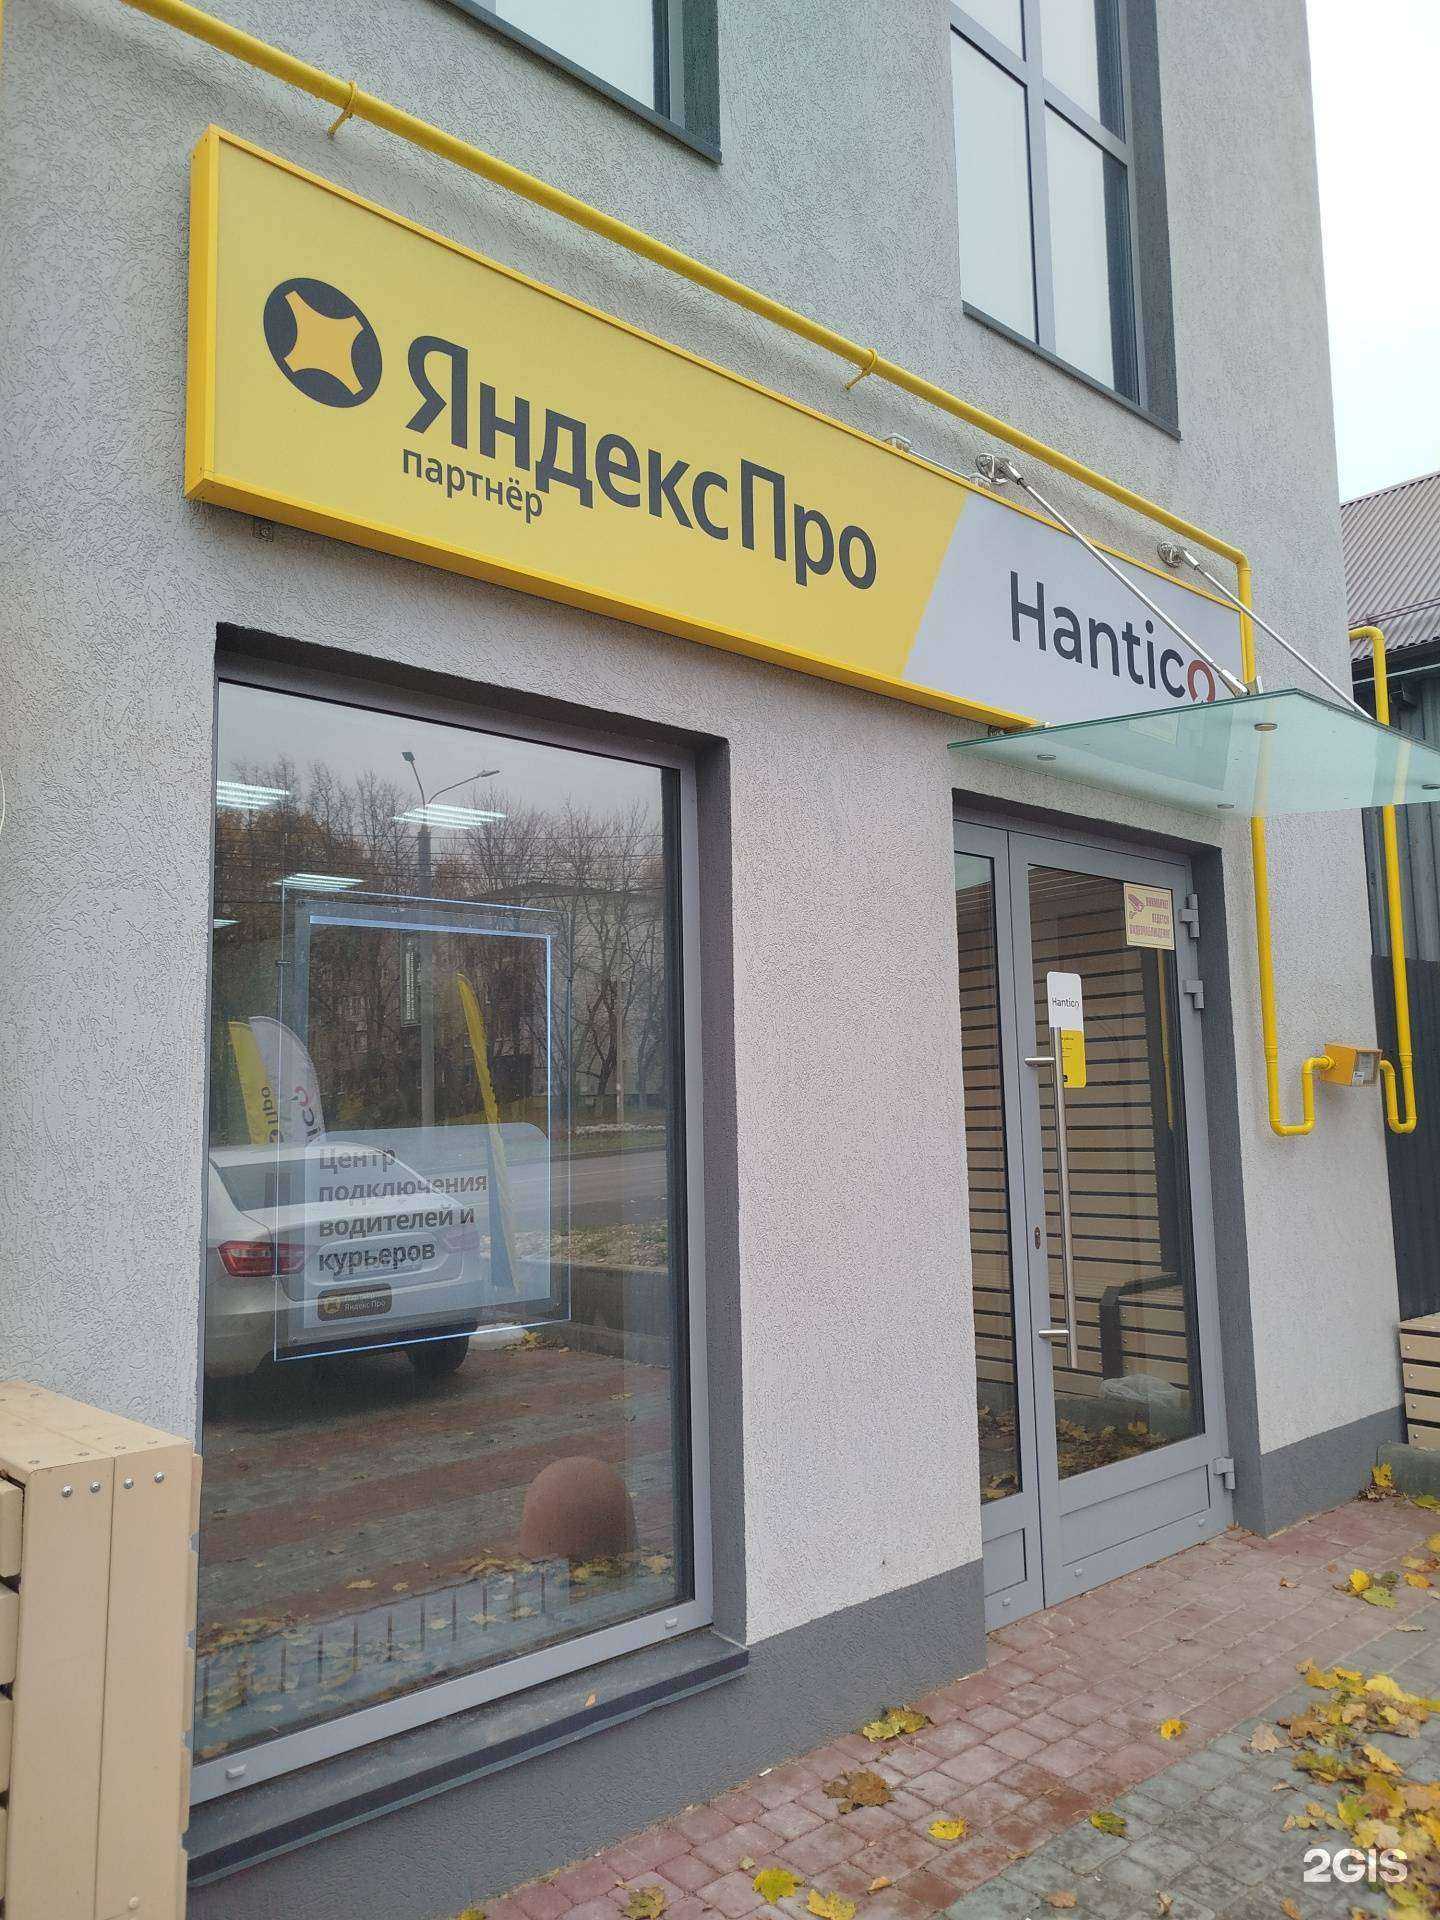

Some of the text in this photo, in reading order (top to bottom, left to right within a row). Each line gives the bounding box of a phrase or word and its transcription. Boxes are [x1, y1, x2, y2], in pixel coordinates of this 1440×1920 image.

[402, 448, 543, 523] партнёр
[319, 1148, 396, 1174] Центр
[319, 1175, 489, 1205] подключения
[319, 1204, 475, 1239] водителей и
[319, 1243, 436, 1277] курьеров
